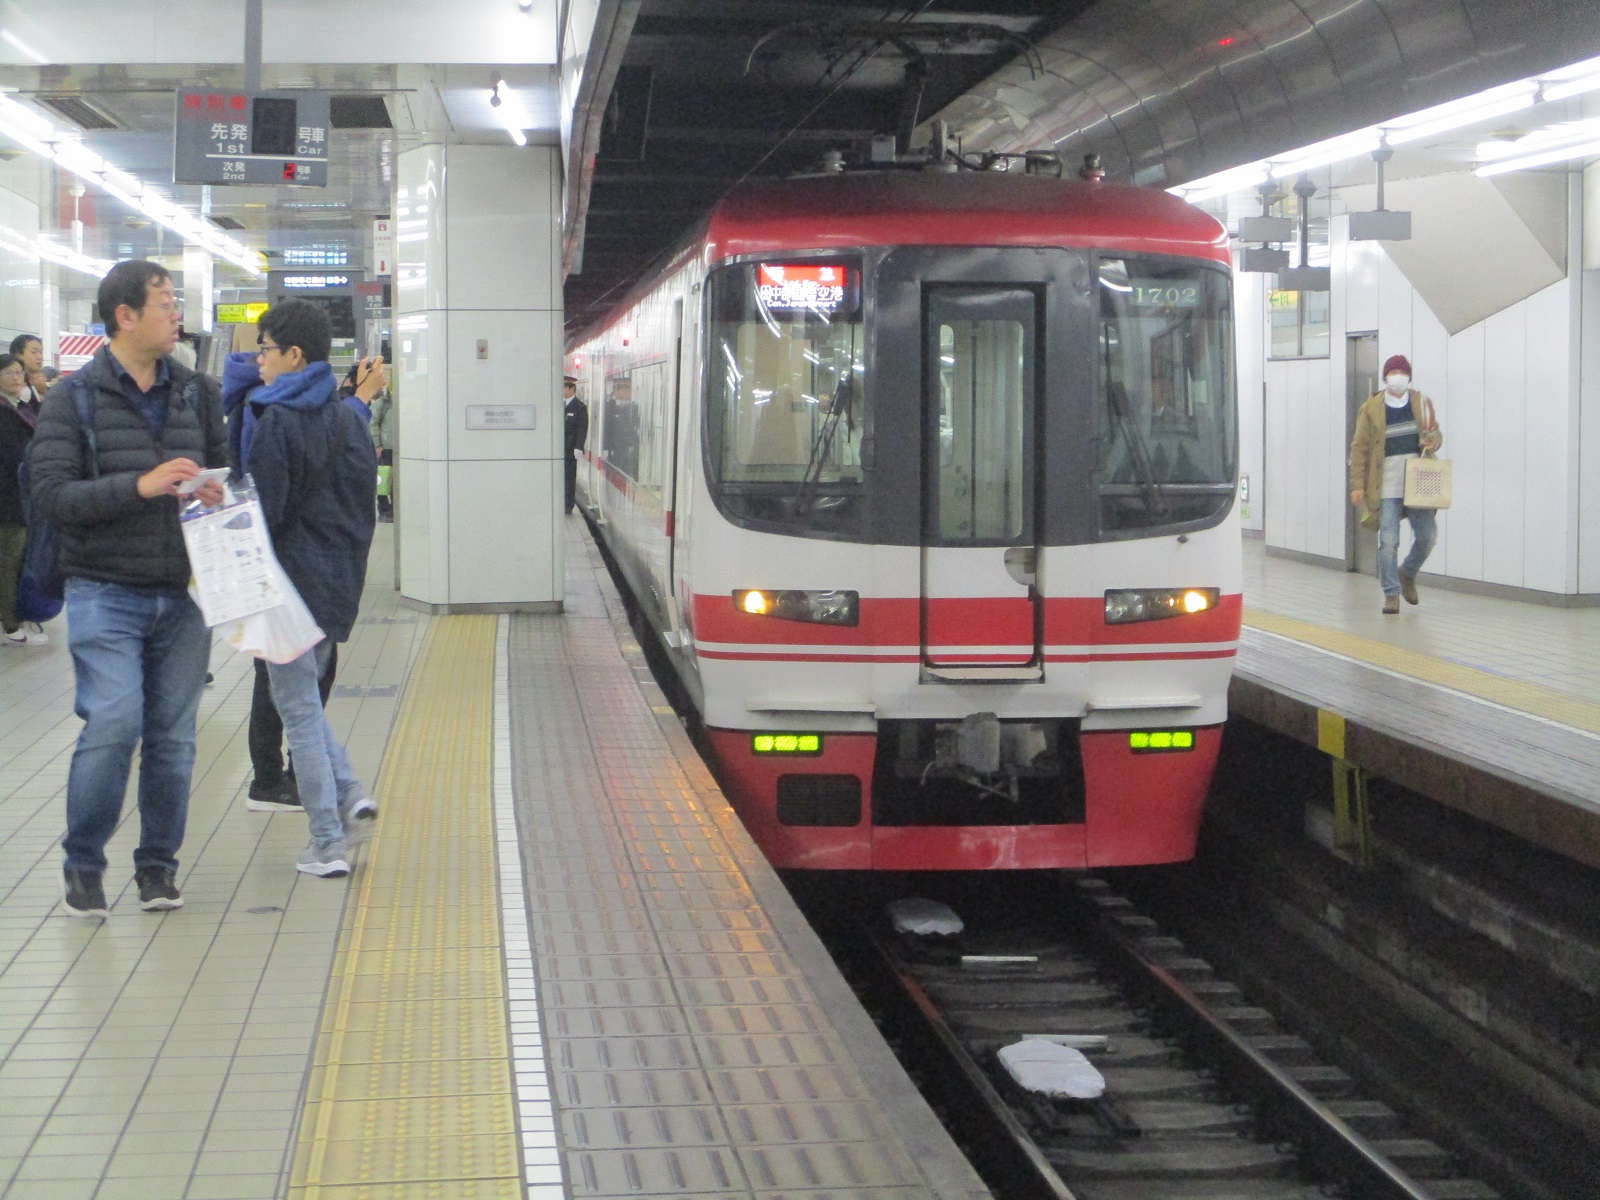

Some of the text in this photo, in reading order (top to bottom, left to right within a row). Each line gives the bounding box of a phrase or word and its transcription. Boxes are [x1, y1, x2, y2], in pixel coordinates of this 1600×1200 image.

[211, 123, 325, 144] 先発 号車
[216, 143, 322, 154] 1st Car
[223, 162, 245, 172] 次発
[282, 163, 296, 179] 2
[1136, 287, 1196, 304] 1702
